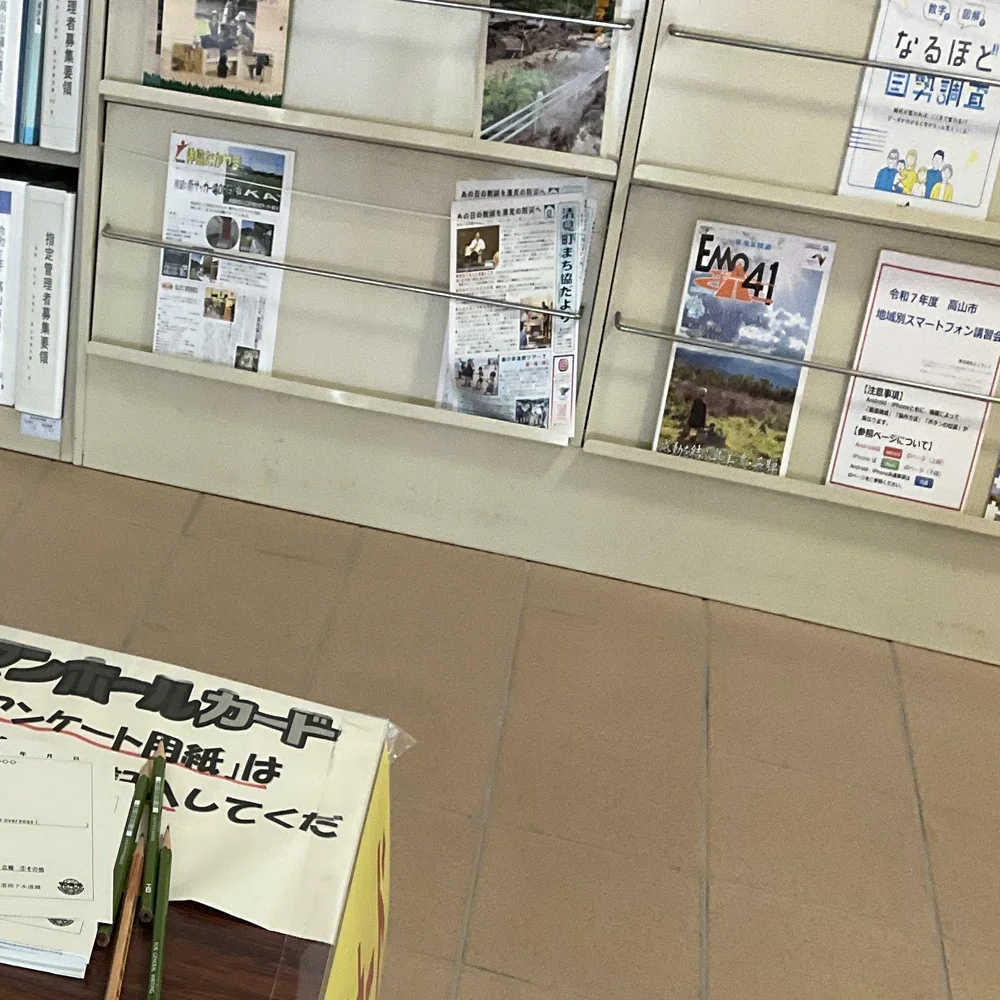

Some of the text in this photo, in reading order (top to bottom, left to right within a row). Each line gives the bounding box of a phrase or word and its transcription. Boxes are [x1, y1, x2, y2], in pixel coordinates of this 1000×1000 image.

[895, 30, 999, 72] なるほど
[947, 299, 978, 314] 高山市
